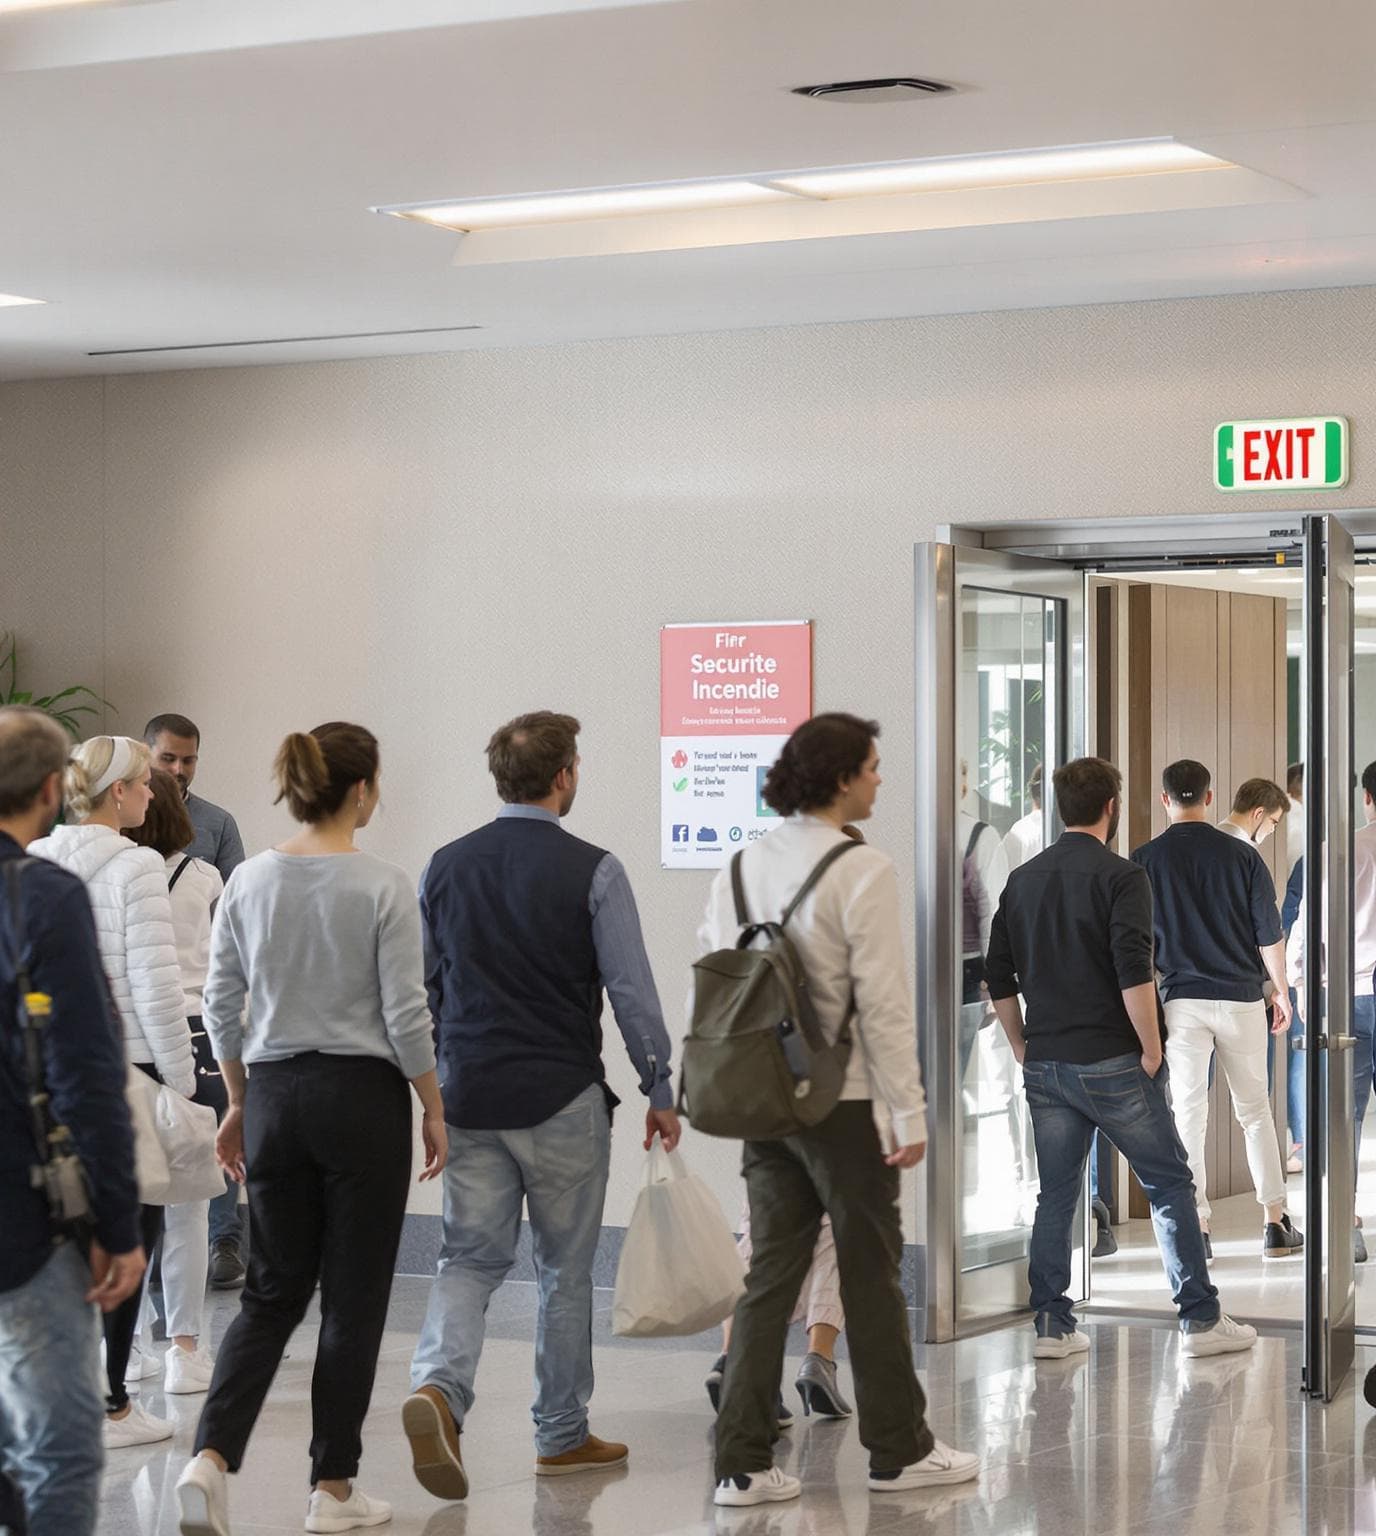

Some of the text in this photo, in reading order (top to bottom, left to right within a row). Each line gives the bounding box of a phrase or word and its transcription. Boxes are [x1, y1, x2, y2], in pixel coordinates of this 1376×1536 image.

[1244, 429, 1314, 480] EXIT
[691, 653, 776, 673] Securite
[694, 679, 779, 699] Incendie
